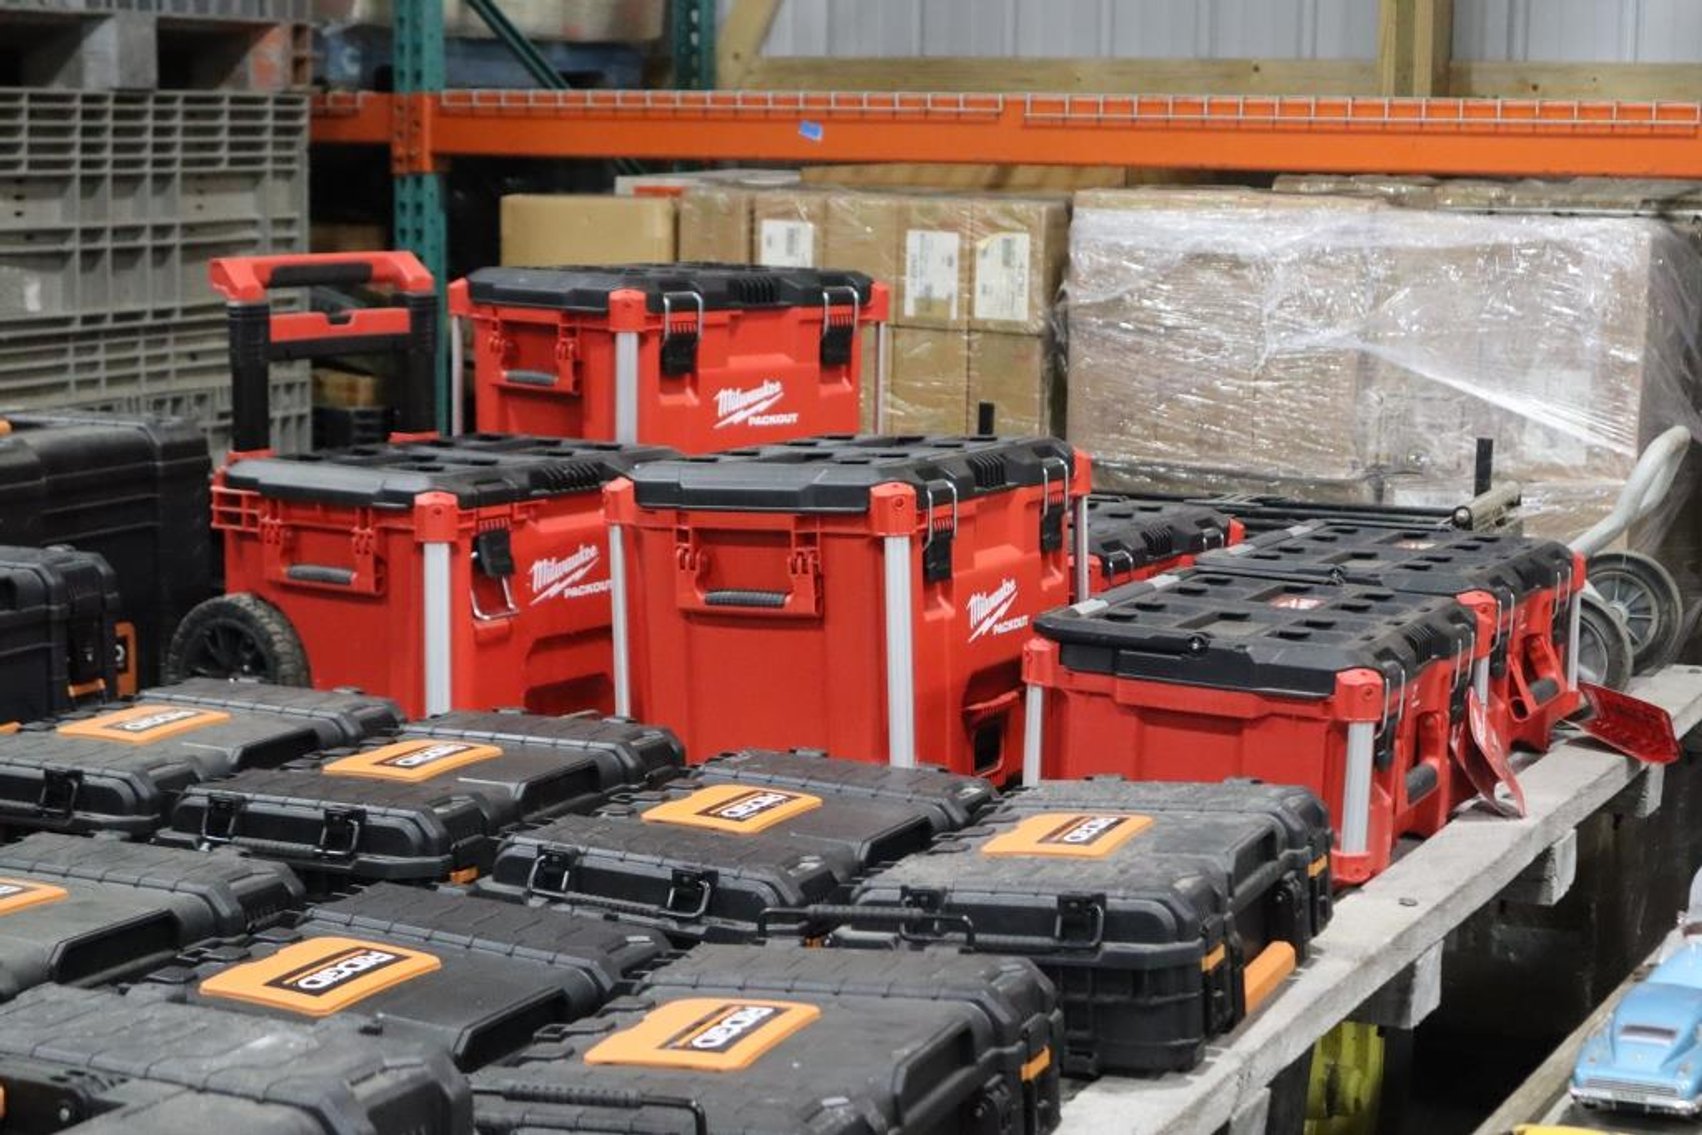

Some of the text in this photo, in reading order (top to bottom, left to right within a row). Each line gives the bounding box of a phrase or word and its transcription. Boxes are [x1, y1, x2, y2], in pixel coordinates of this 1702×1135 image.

[713, 379, 782, 418] Milwaukee
[748, 413, 799, 426] PACKOUT
[527, 545, 598, 593] Milwaukee
[298, 951, 397, 989] RIDGID
[690, 1005, 775, 1049] RIDGID
